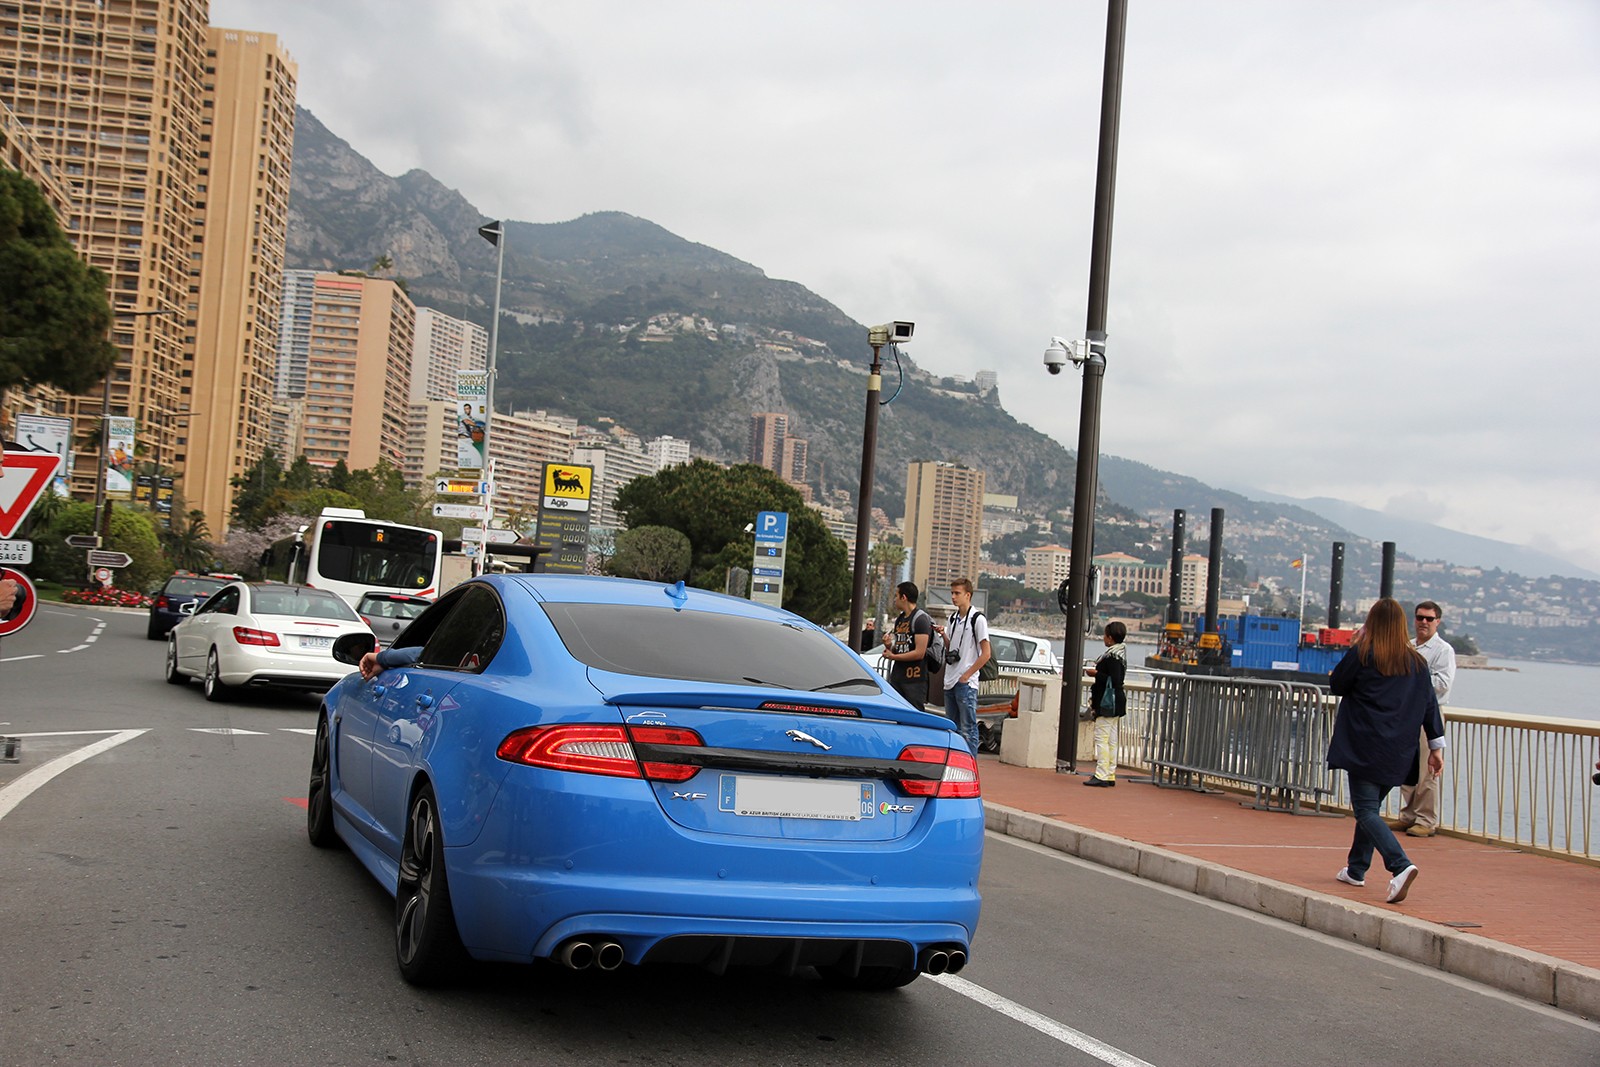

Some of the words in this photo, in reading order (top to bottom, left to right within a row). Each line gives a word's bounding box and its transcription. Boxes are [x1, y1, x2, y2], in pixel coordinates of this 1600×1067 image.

[550, 498, 568, 508] Agip
[764, 514, 777, 531] P
[376, 533, 384, 542] R
[906, 666, 921, 678] 02
[670, 790, 707, 801] XF
[725, 796, 731, 804] F
[861, 801, 873, 815] 06
